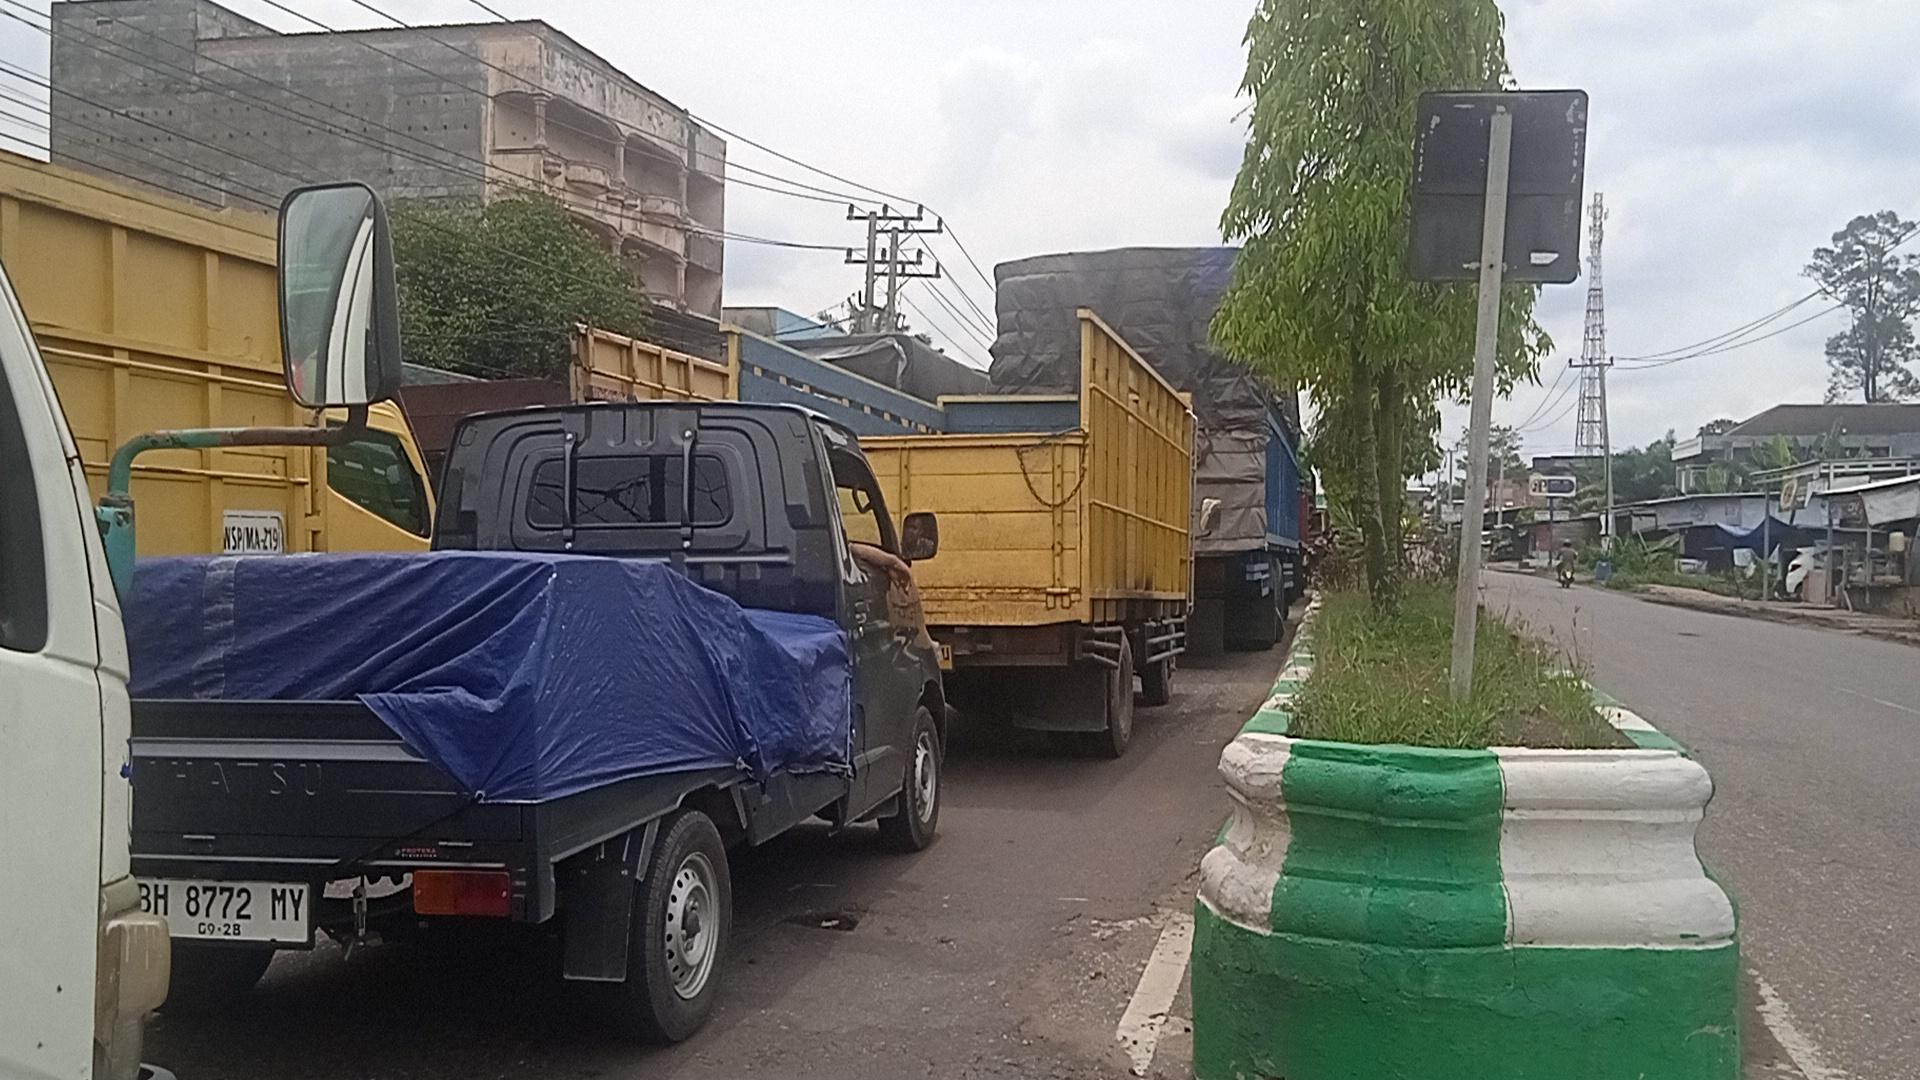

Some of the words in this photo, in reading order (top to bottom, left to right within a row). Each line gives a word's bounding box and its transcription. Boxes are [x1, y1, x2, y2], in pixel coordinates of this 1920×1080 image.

[138, 883, 169, 916] BH
[185, 885, 252, 920] 8772
[271, 888, 304, 921] MY
